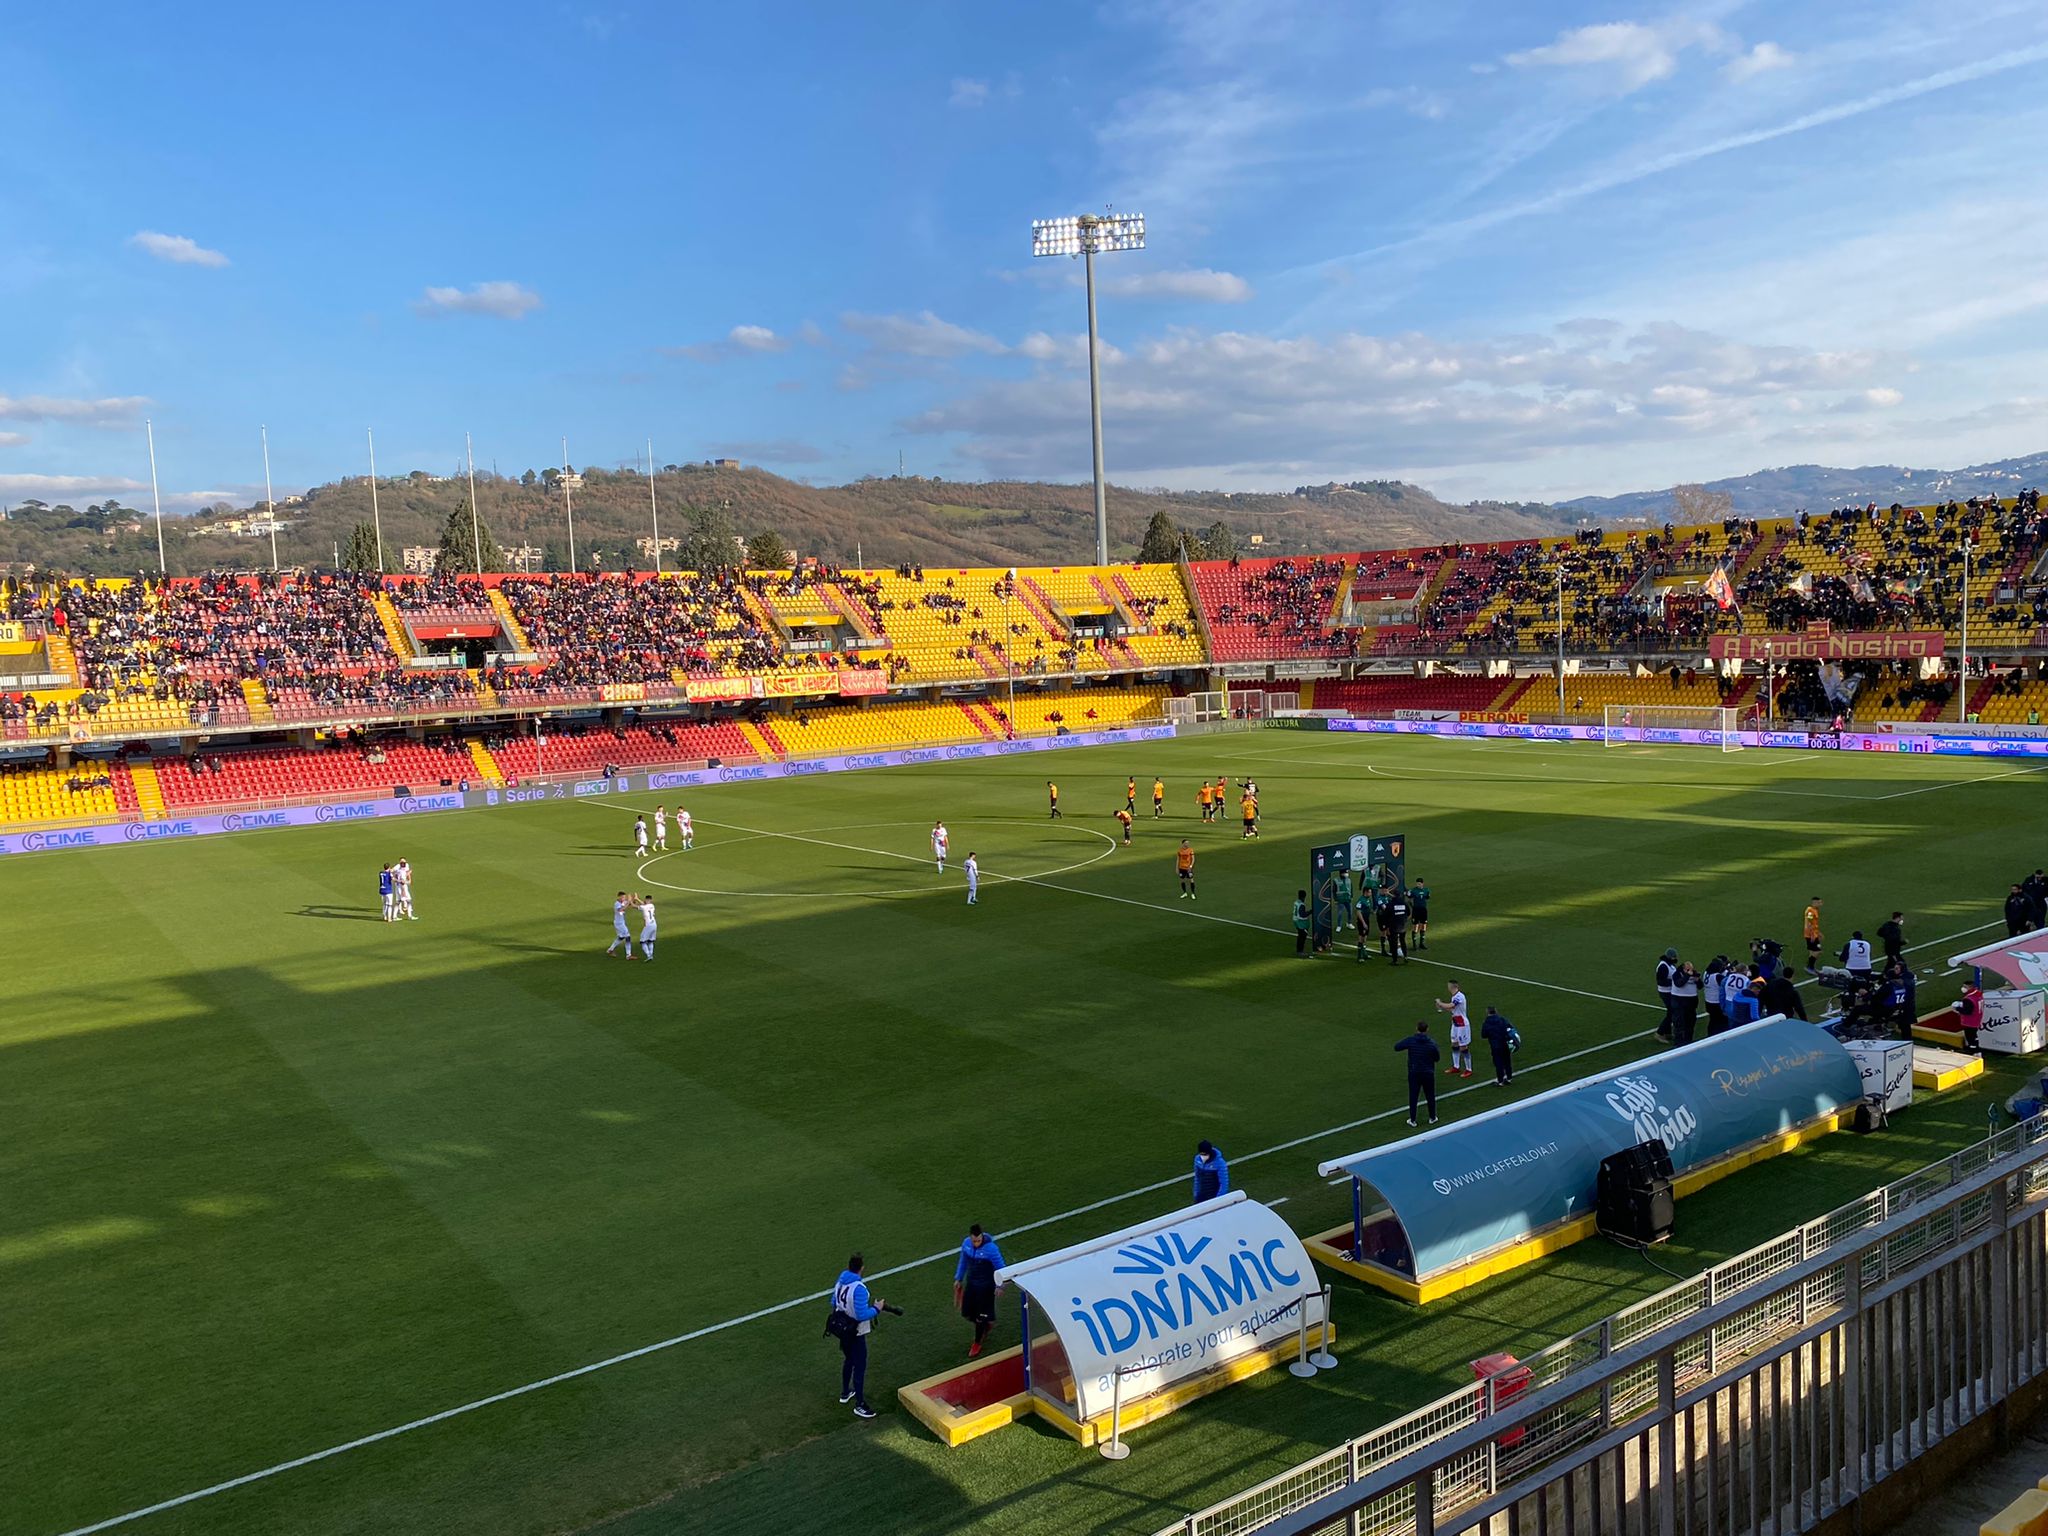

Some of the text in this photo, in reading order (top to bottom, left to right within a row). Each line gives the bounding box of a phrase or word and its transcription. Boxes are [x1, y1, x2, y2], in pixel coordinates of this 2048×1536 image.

[1723, 636, 1926, 657] A Modo Nostro
[1459, 712, 1528, 722] PETRONE
[1810, 740, 1838, 748] 00:00
[1863, 740, 1929, 752] Bambini
[575, 781, 608, 794] BKT
[506, 788, 545, 802] Serie
[1856, 942, 1865, 954] 3
[1728, 974, 1744, 990] 20
[1449, 1141, 1559, 1188] WWW.CAFFEALOIA.IT
[836, 1286, 850, 1310] 14
[1196, 1325, 1234, 1358] your
